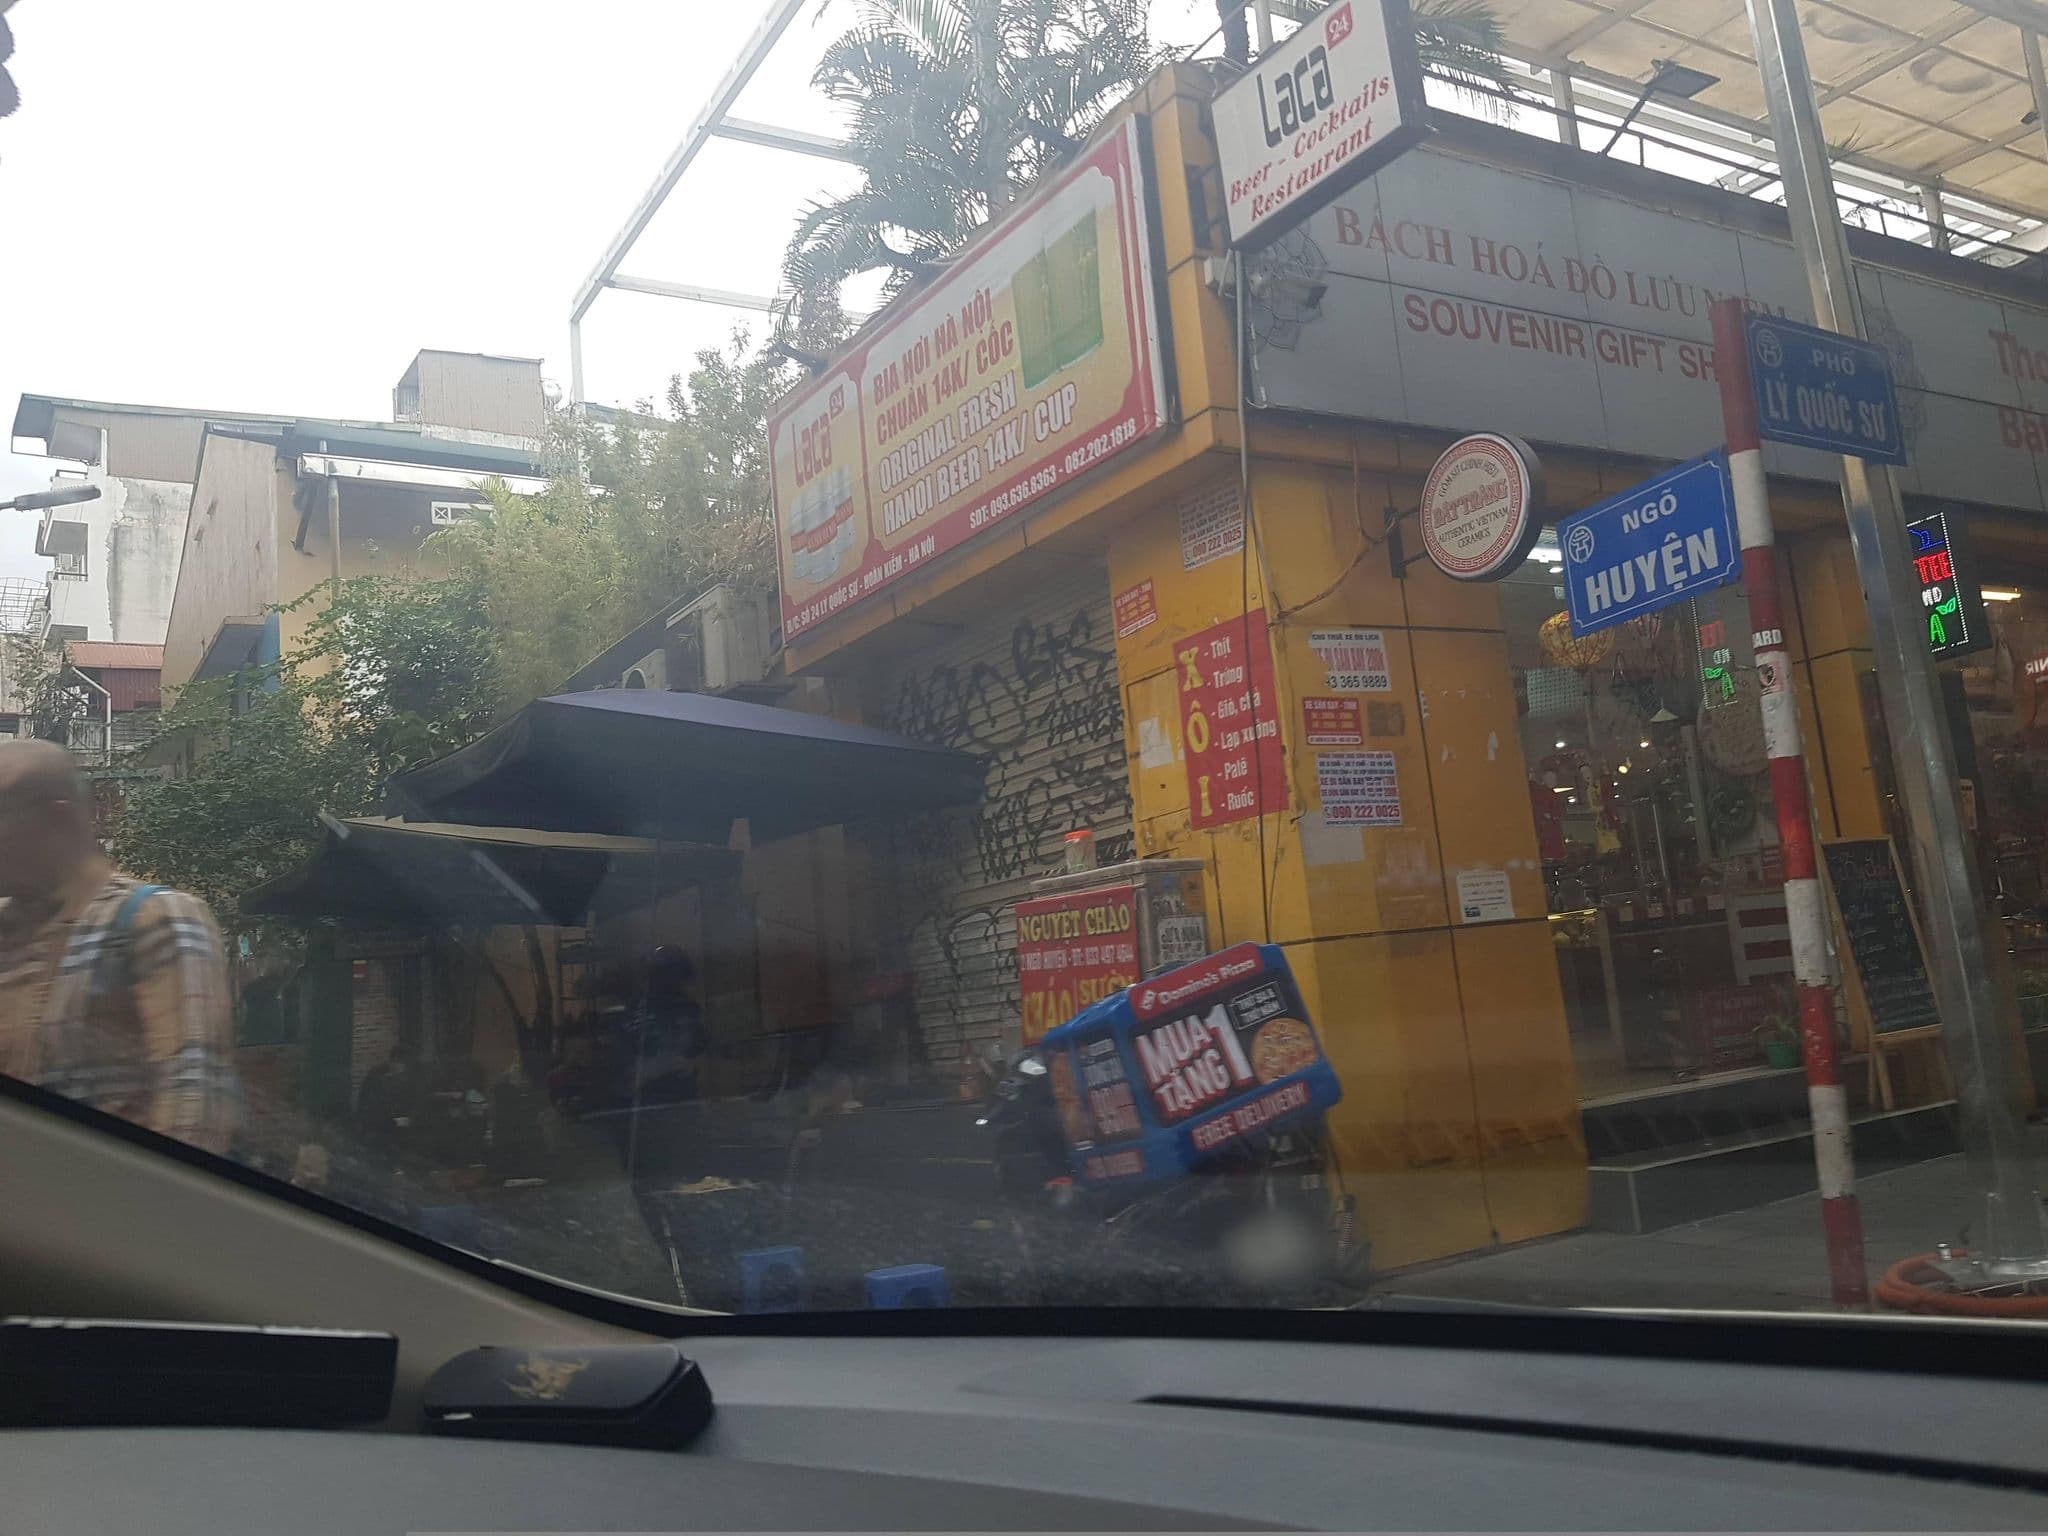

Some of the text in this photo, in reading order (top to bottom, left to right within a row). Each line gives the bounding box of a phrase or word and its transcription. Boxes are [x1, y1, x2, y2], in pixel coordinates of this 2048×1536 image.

[1328, 15, 1350, 41] 24
[1231, 161, 1272, 205] Beer
[1294, 76, 1389, 161] Cocktails
[1252, 117, 1374, 222] Restaurant
[872, 361, 899, 406] BIA
[934, 312, 959, 357] HÀ
[976, 318, 1014, 375] CỐC
[1403, 293, 1719, 383] SOUVENIR GIFT SH
[1812, 348, 1856, 376] PHỐ
[1765, 371, 1790, 422] LÝ
[1796, 381, 1853, 434] QUỐC
[878, 369, 1018, 494] ORIGINAL FRESH
[882, 474, 935, 537] HANOI
[936, 445, 982, 503] BEER
[1033, 381, 1077, 443] CUP
[1438, 506, 1509, 543] AUTHENTIC VIETNAM
[1622, 487, 1678, 534] NGÕ
[1457, 527, 1491, 549] CERAMICS
[1585, 526, 1720, 614] HUYỆN
[1210, 636, 1232, 659] Thịt
[1752, 629, 1783, 650] ARD
[1213, 664, 1243, 689] Trứng
[1221, 730, 1240, 752] Lạp
[1227, 786, 1255, 811] Ruốc
[1354, 805, 1374, 818] 222
[1375, 805, 1400, 818] 0025
[1019, 904, 1081, 944] NGUYỆT
[1084, 897, 1131, 934] CHÁO
[1219, 958, 1256, 979] Pizza
[1135, 1014, 1213, 1085] MUA
[1202, 1003, 1254, 1081] 1
